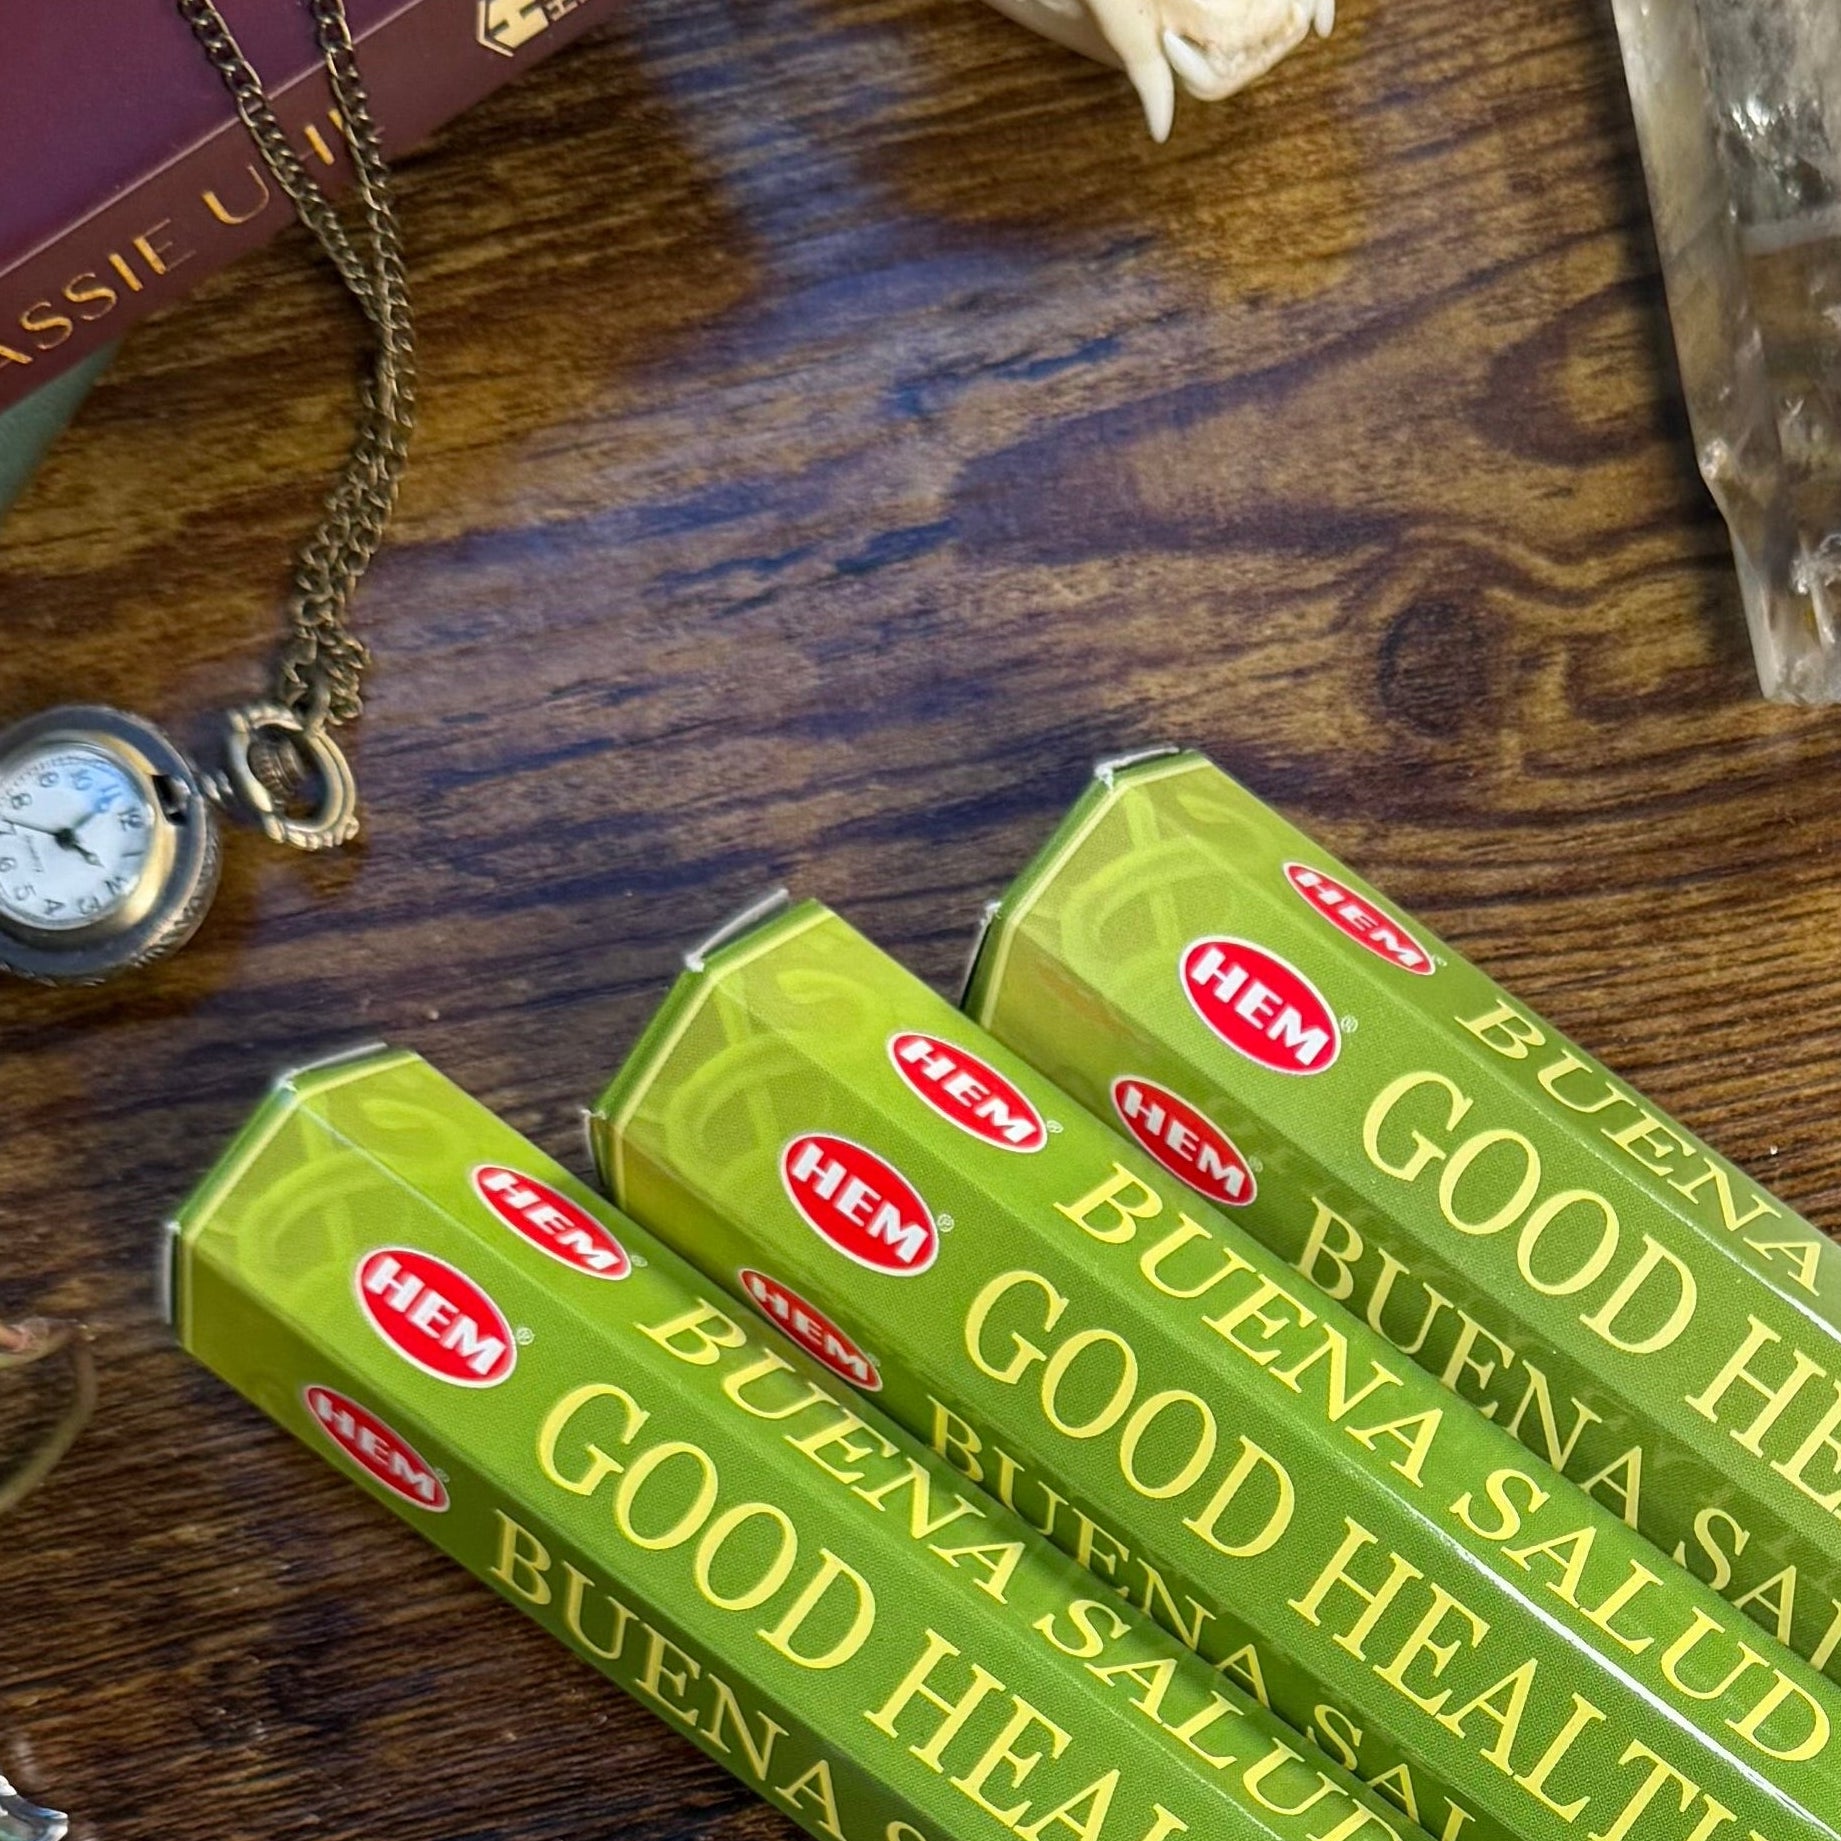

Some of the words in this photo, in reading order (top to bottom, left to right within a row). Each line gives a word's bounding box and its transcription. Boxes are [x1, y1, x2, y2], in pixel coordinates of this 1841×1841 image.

[1293, 868, 1424, 969] HEM
[1190, 946, 1331, 1067] HEM
[901, 1038, 1034, 1145] HEM
[1121, 1083, 1249, 1198] HEM
[1455, 998, 1824, 1297] BUENA
[479, 1171, 615, 1274] HEM
[791, 1142, 932, 1266] HEM
[1362, 1070, 1698, 1355] GOOD
[361, 1256, 510, 1381] HEM
[743, 1273, 879, 1386] HEM
[1290, 1196, 1646, 1530] BUENA
[309, 1391, 441, 1505] HEM
[637, 1297, 1026, 1605] BUENA
[964, 1270, 1295, 1558] GOOD
[1054, 1161, 1443, 1489] BUENA
[1449, 1468, 1832, 1763] SALUD
[537, 1383, 877, 1670] GOOD
[927, 1394, 1272, 1710] BUENA
